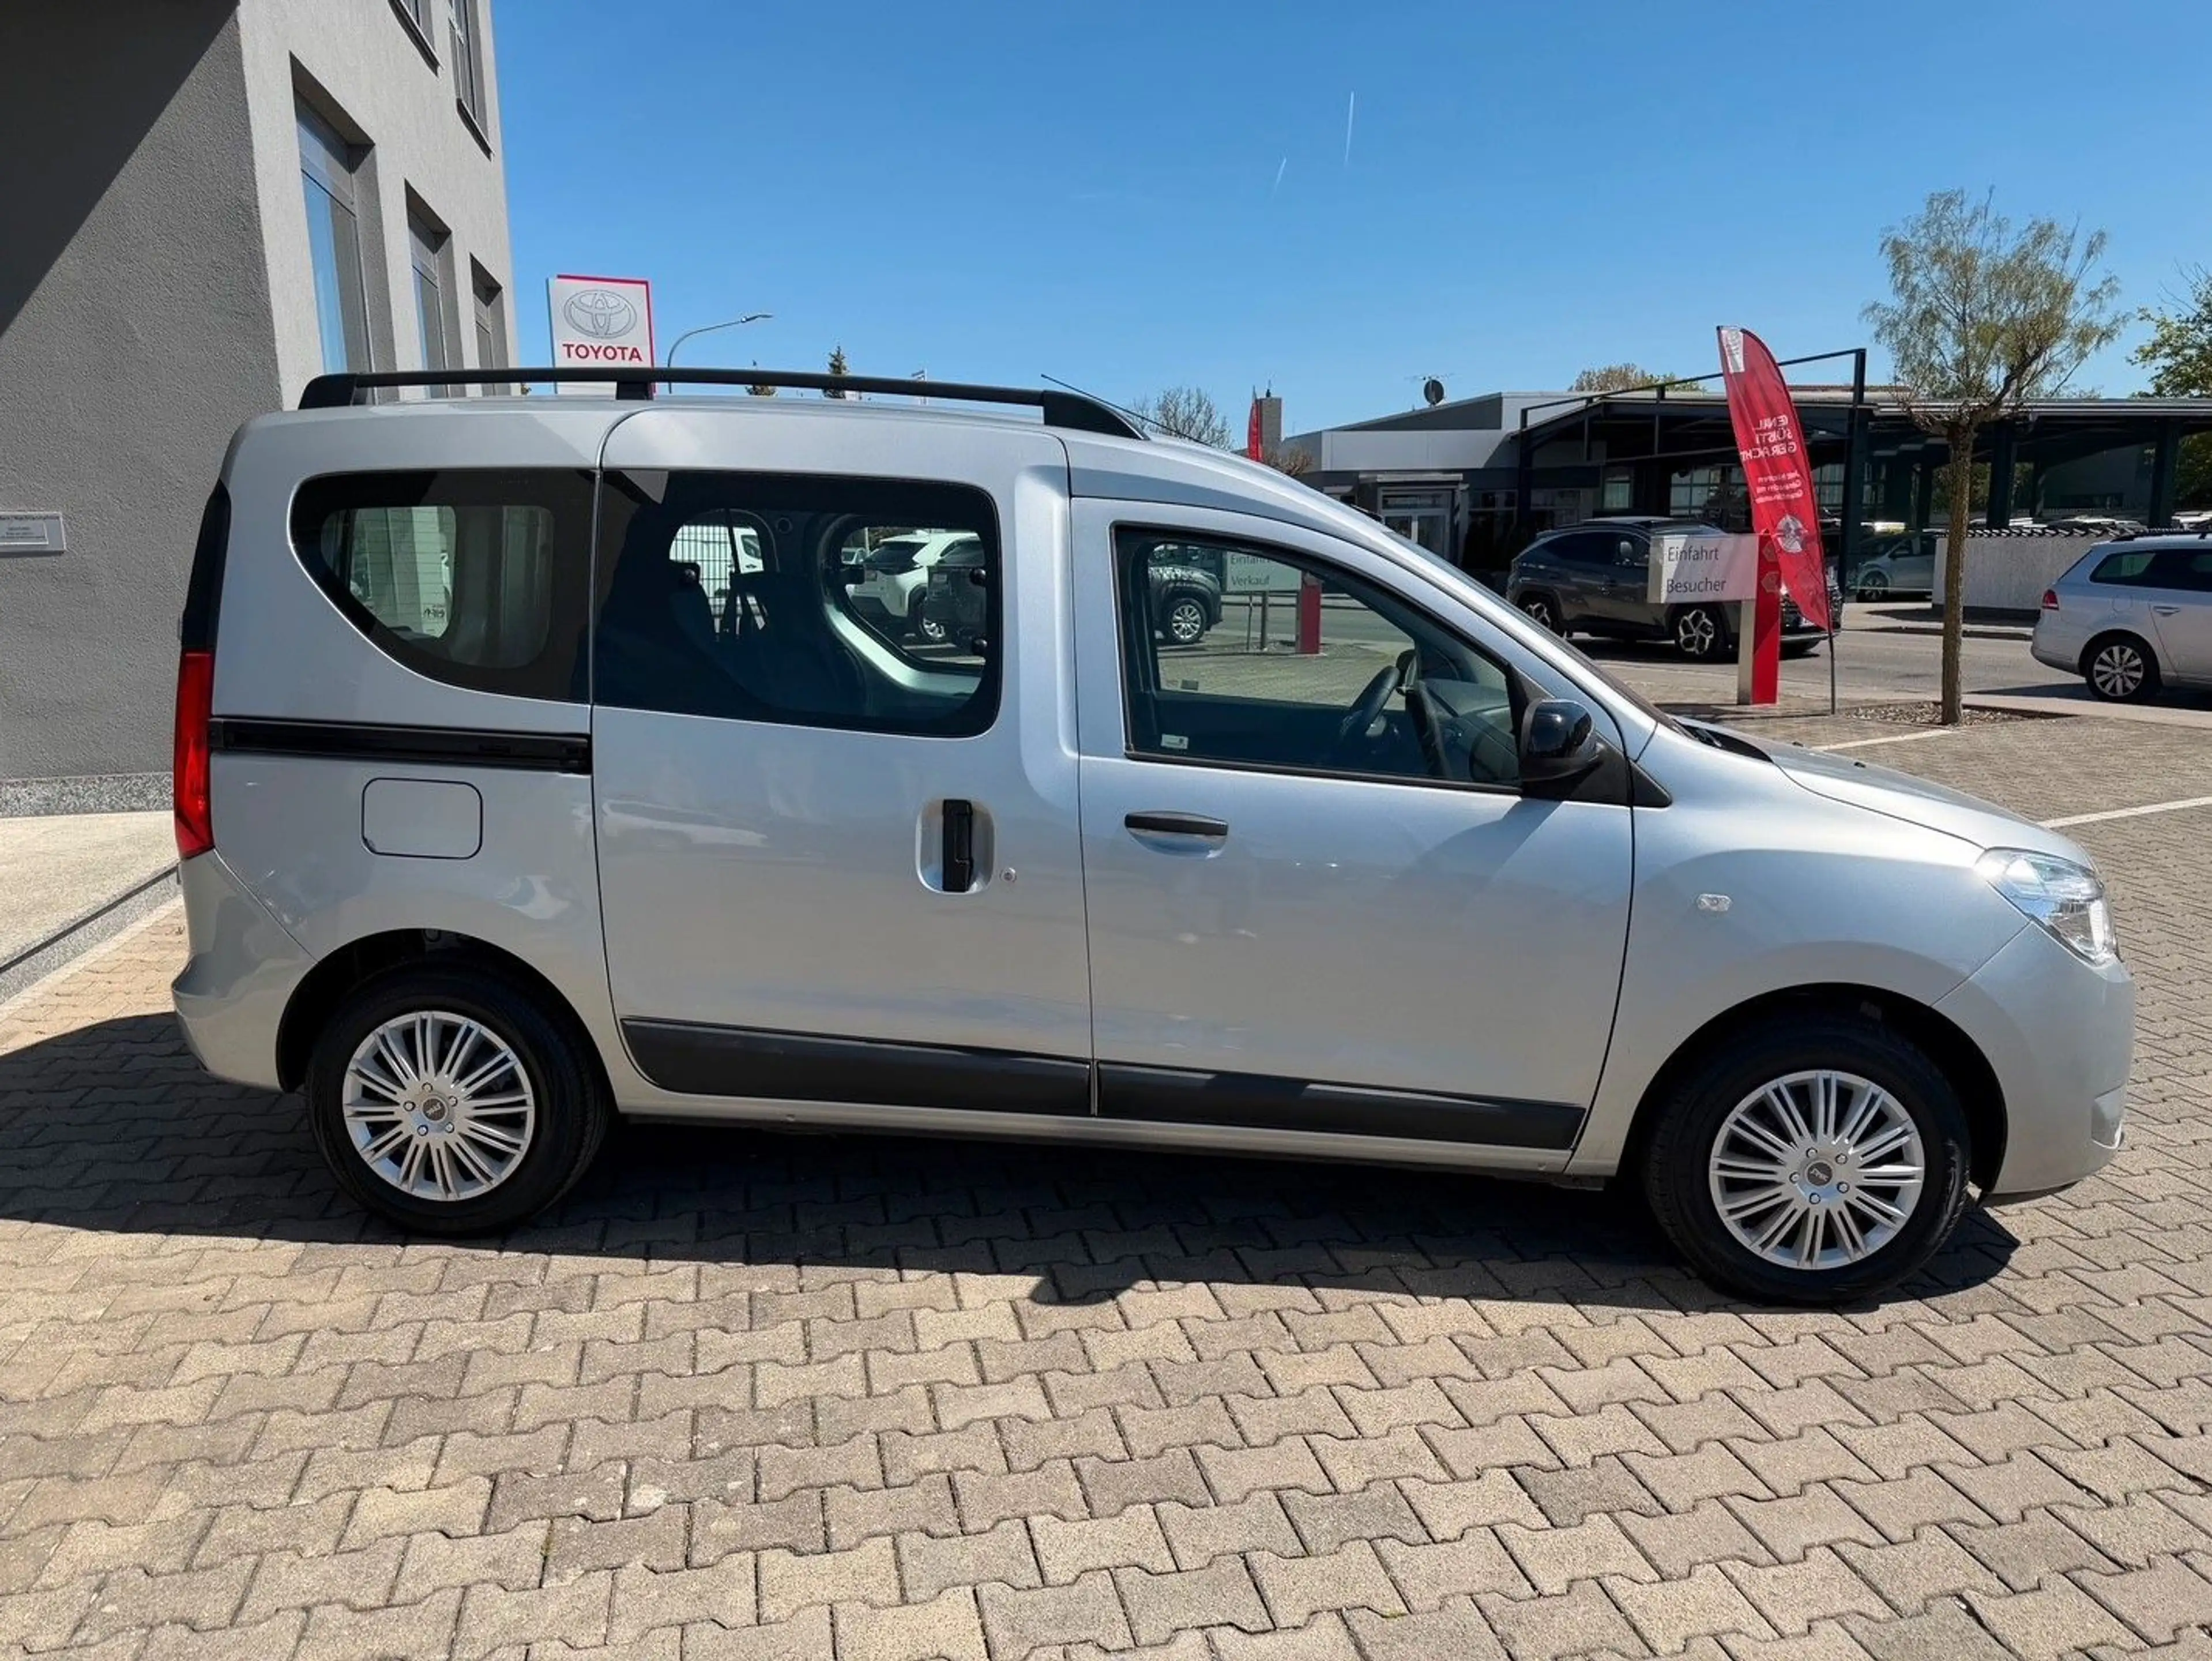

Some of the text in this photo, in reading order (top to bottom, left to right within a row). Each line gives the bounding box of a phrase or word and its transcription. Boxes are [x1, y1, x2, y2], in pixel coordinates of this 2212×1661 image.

[562, 344, 643, 362] TOYOTA
[1668, 546, 1719, 561] Einfahrt
[1231, 575, 1270, 587] Verkauf
[1666, 577, 1726, 593] Besucher
